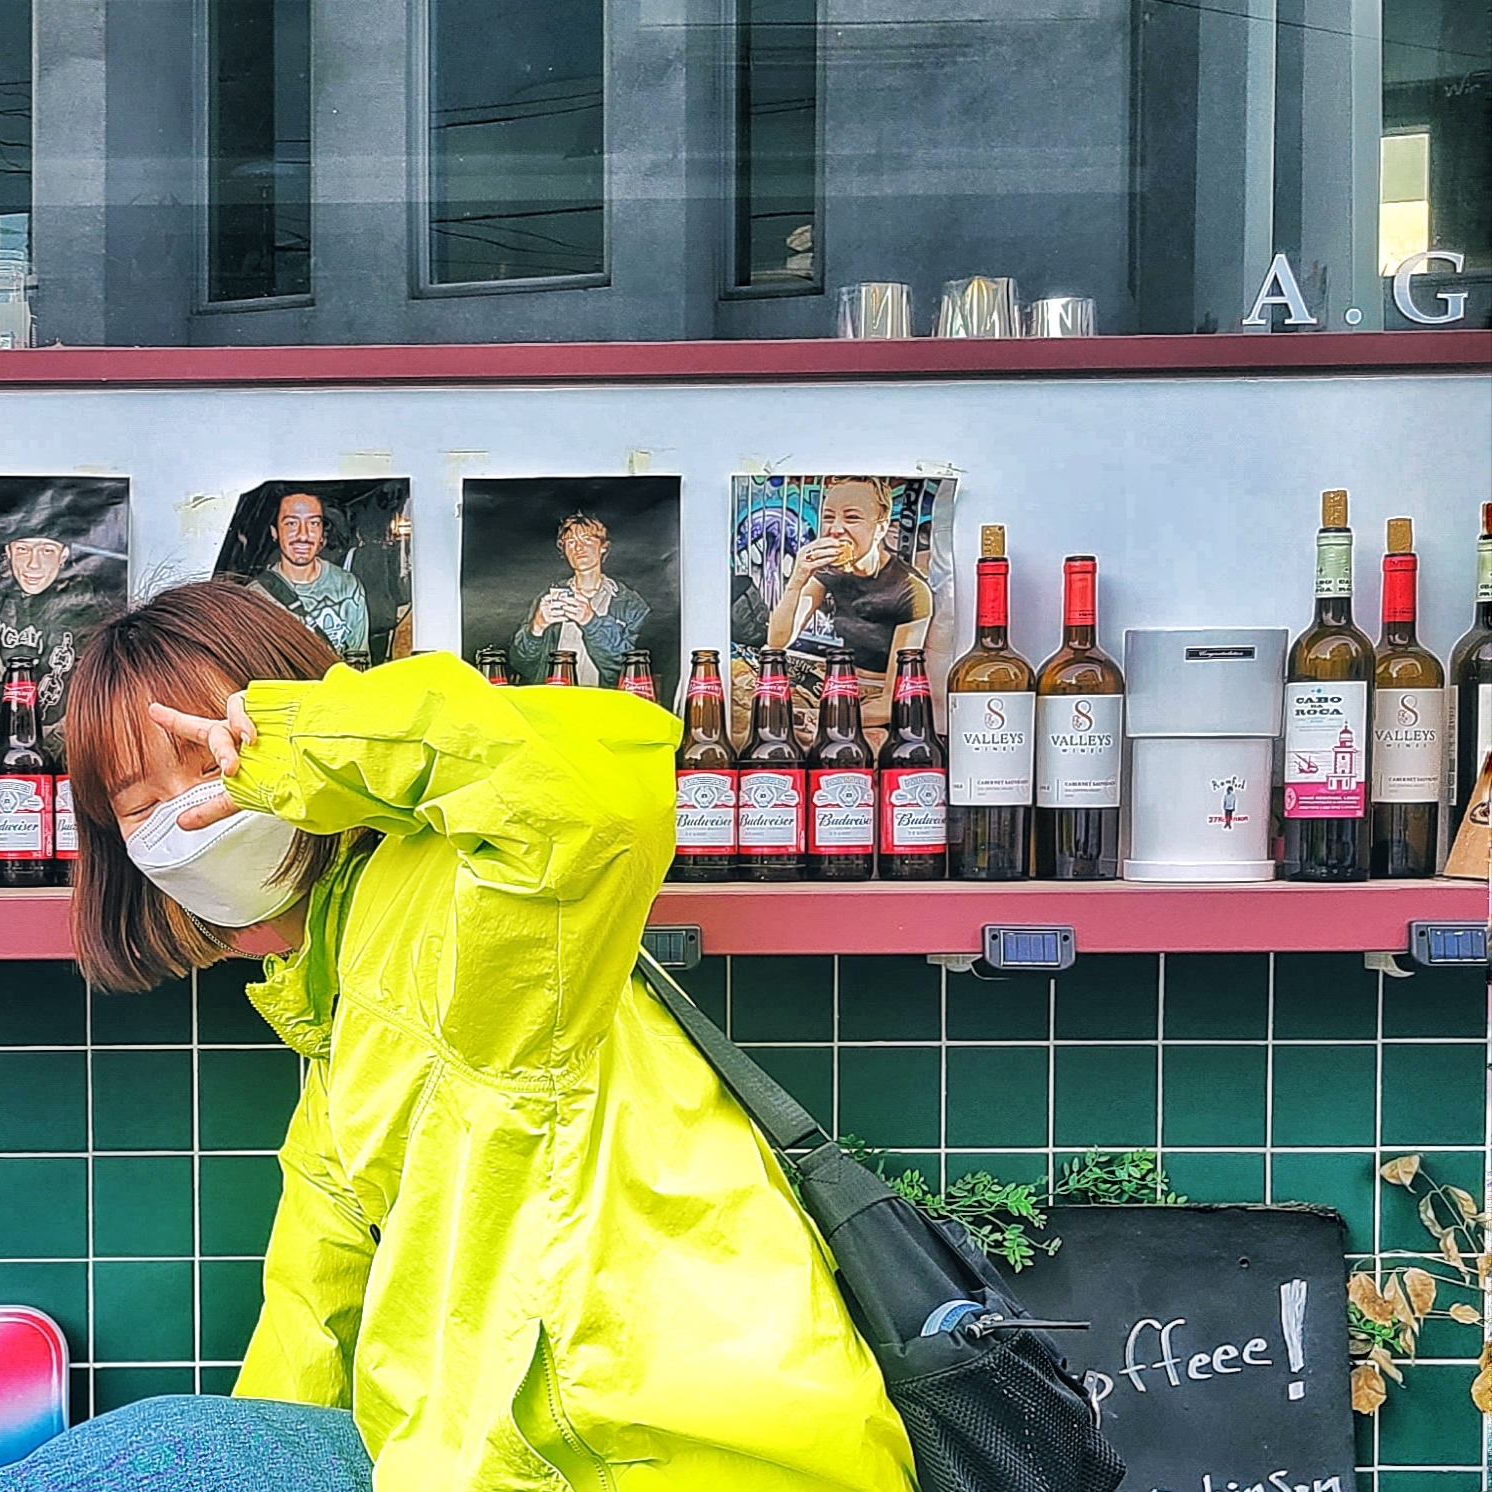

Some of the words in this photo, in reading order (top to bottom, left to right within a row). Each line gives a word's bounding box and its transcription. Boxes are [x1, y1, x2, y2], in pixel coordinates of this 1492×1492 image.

[1295, 708, 1344, 716] ROCA
[963, 732, 1025, 745] VALLEYS
[1050, 734, 1113, 747] VALLEYS
[1375, 729, 1436, 742] VALLEYS
[676, 813, 733, 828] Budweiser
[739, 813, 795, 828] Budweiser
